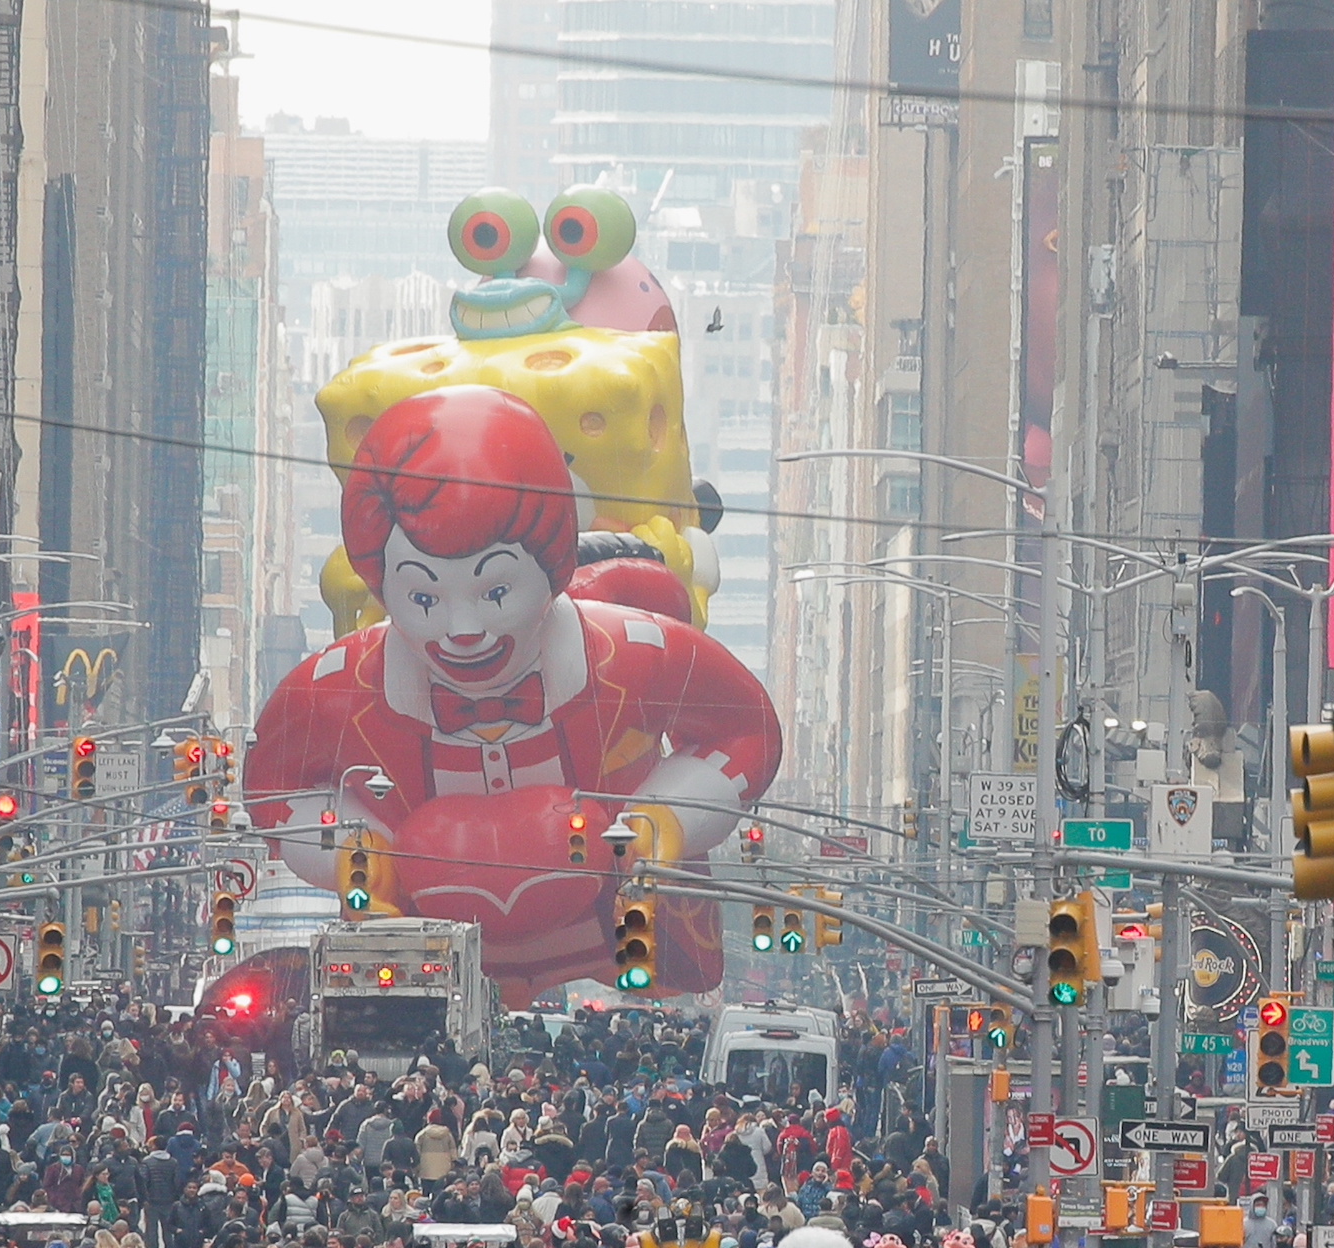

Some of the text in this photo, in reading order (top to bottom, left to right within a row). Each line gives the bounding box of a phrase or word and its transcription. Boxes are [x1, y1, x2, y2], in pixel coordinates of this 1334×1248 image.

[118, 757, 136, 767] LANE
[980, 780, 1035, 792] W 39 ST
[980, 794, 1035, 806] CLOSED
[975, 808, 1037, 821] AT 9 AVE
[974, 822, 1036, 834] SAT SUN
[1087, 828, 1106, 843] TO
[1204, 958, 1234, 972] Rock
[946, 983, 964, 993] WAY
[1184, 1035, 1196, 1050] W
[1201, 1035, 1216, 1052] 45
[1287, 1037, 1331, 1048] Broadway
[1261, 1109, 1293, 1117] PHOTO
[1134, 1130, 1160, 1143] ONE
[1171, 1131, 1198, 1144] WAY
[1279, 1131, 1301, 1143] ONE
